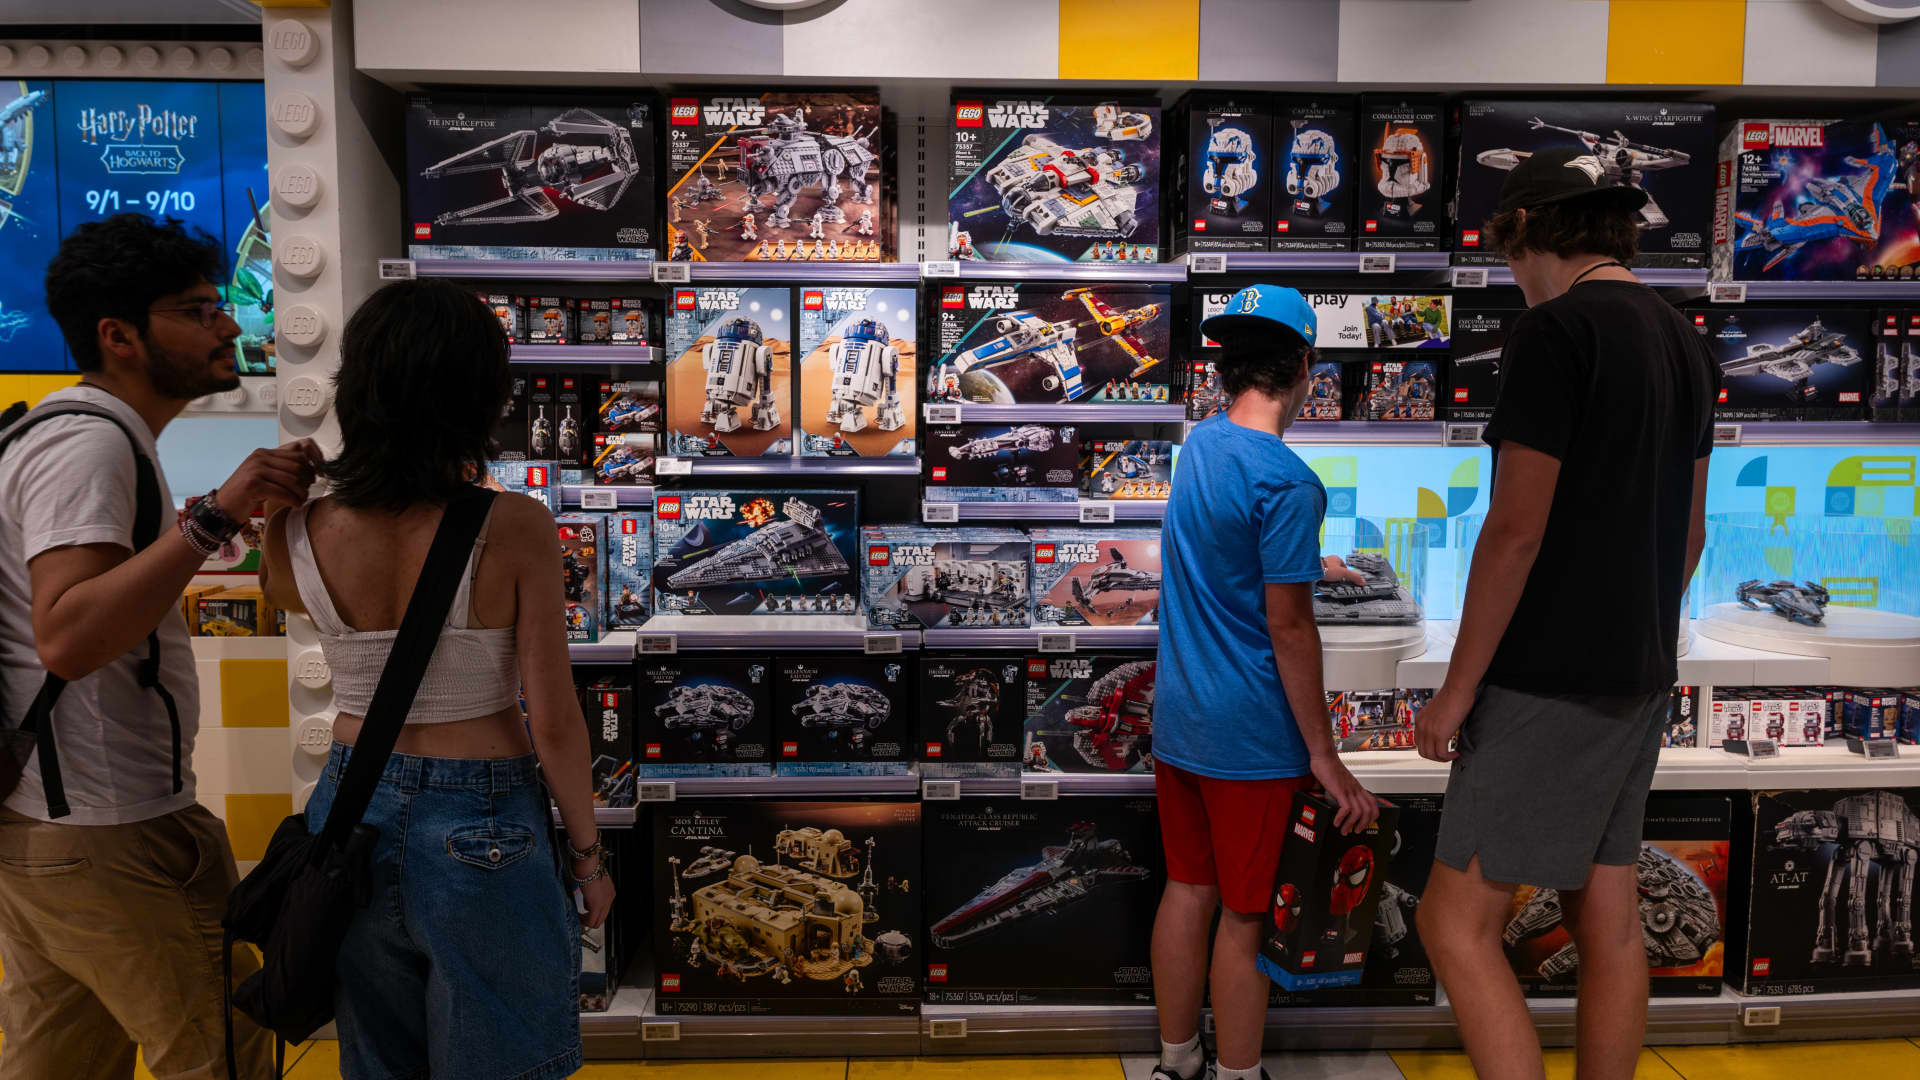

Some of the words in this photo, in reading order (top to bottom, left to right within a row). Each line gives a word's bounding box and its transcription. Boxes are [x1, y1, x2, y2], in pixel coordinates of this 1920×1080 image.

[273, 31, 305, 50] LEGO
[704, 98, 765, 111] STAR
[988, 101, 1049, 115] STAR
[276, 103, 309, 122] LEGO
[673, 106, 697, 117] LEGO
[957, 108, 982, 119] LEGO
[704, 110, 765, 125] WARS
[988, 114, 1049, 128] WARS
[77, 107, 136, 145] Harry
[137, 104, 198, 140] Potter
[428, 119, 440, 127] TIE
[442, 119, 496, 127] INTERCEPTOR
[672, 130, 687, 140] 9+
[956, 132, 977, 142] 10+
[1744, 130, 1768, 142] LEGO
[1775, 127, 1823, 146] MARVEL
[110, 155, 177, 169] HOGWARTS
[1743, 155, 1762, 164] 12+
[1719, 164, 1728, 186] LEGO
[279, 175, 313, 194] LEGO
[86, 189, 119, 215] 9/1
[146, 190, 195, 215] 9/10
[1714, 192, 1728, 244] MARVEL
[617, 228, 649, 236] STAR
[617, 235, 649, 243] WARS
[281, 246, 314, 265] LEGO
[698, 292, 739, 300] STAR
[826, 292, 867, 300] STAR
[943, 292, 963, 302] LEGO
[968, 286, 1019, 298] STAR
[678, 296, 694, 304] LEGO
[698, 299, 739, 309] WARS
[806, 296, 822, 304] LEGO
[826, 299, 867, 310] WARS
[968, 297, 1019, 309] WARS
[1237, 288, 1262, 313] B
[1313, 294, 1348, 308] play
[942, 313, 955, 321] 9+
[1840, 393, 1860, 401] MARVEL
[659, 503, 680, 512] LEGO
[685, 497, 735, 508] STAR
[685, 507, 735, 519] WARS
[660, 523, 675, 531] 10+
[622, 536, 631, 566] WARS
[629, 536, 637, 566] STAR
[892, 547, 935, 556] STAR
[1036, 549, 1053, 558] LEGO
[1058, 544, 1099, 554] STAR
[872, 552, 887, 560] LEGO
[892, 555, 935, 565] WARS
[1058, 553, 1099, 563] WARS
[1029, 664, 1046, 672] LEGO
[1050, 660, 1093, 669] STAR
[1050, 668, 1093, 678] WARS
[602, 709, 612, 741] WARS
[609, 709, 618, 741] STAR
[674, 818, 693, 826] MOS
[695, 818, 720, 826] EISLEY
[670, 826, 724, 836] CANTINA
[1295, 823, 1315, 841] MARVEL
[1770, 872, 1808, 883] AT-AT
[1344, 953, 1362, 963] MARVEL
[931, 968, 946, 976] LEGO
[1114, 967, 1150, 975] STAR
[1754, 963, 1769, 971] LEGO
[662, 978, 680, 987] LEGO
[878, 977, 914, 985] STAR
[1114, 974, 1150, 983] WARS
[878, 984, 914, 993] WARS
[1788, 985, 1801, 993] 6785
[1802, 985, 1815, 994] pcs
[929, 992, 940, 1000] 18+
[945, 992, 964, 1001] 75367
[969, 992, 984, 1000] 5374
[987, 991, 1014, 1002] pcs/pzs
[662, 1003, 673, 1012] 18+
[678, 1003, 698, 1012] 75290
[703, 1003, 717, 1012] 3187
[719, 1002, 746, 1013] pcs/pzs
